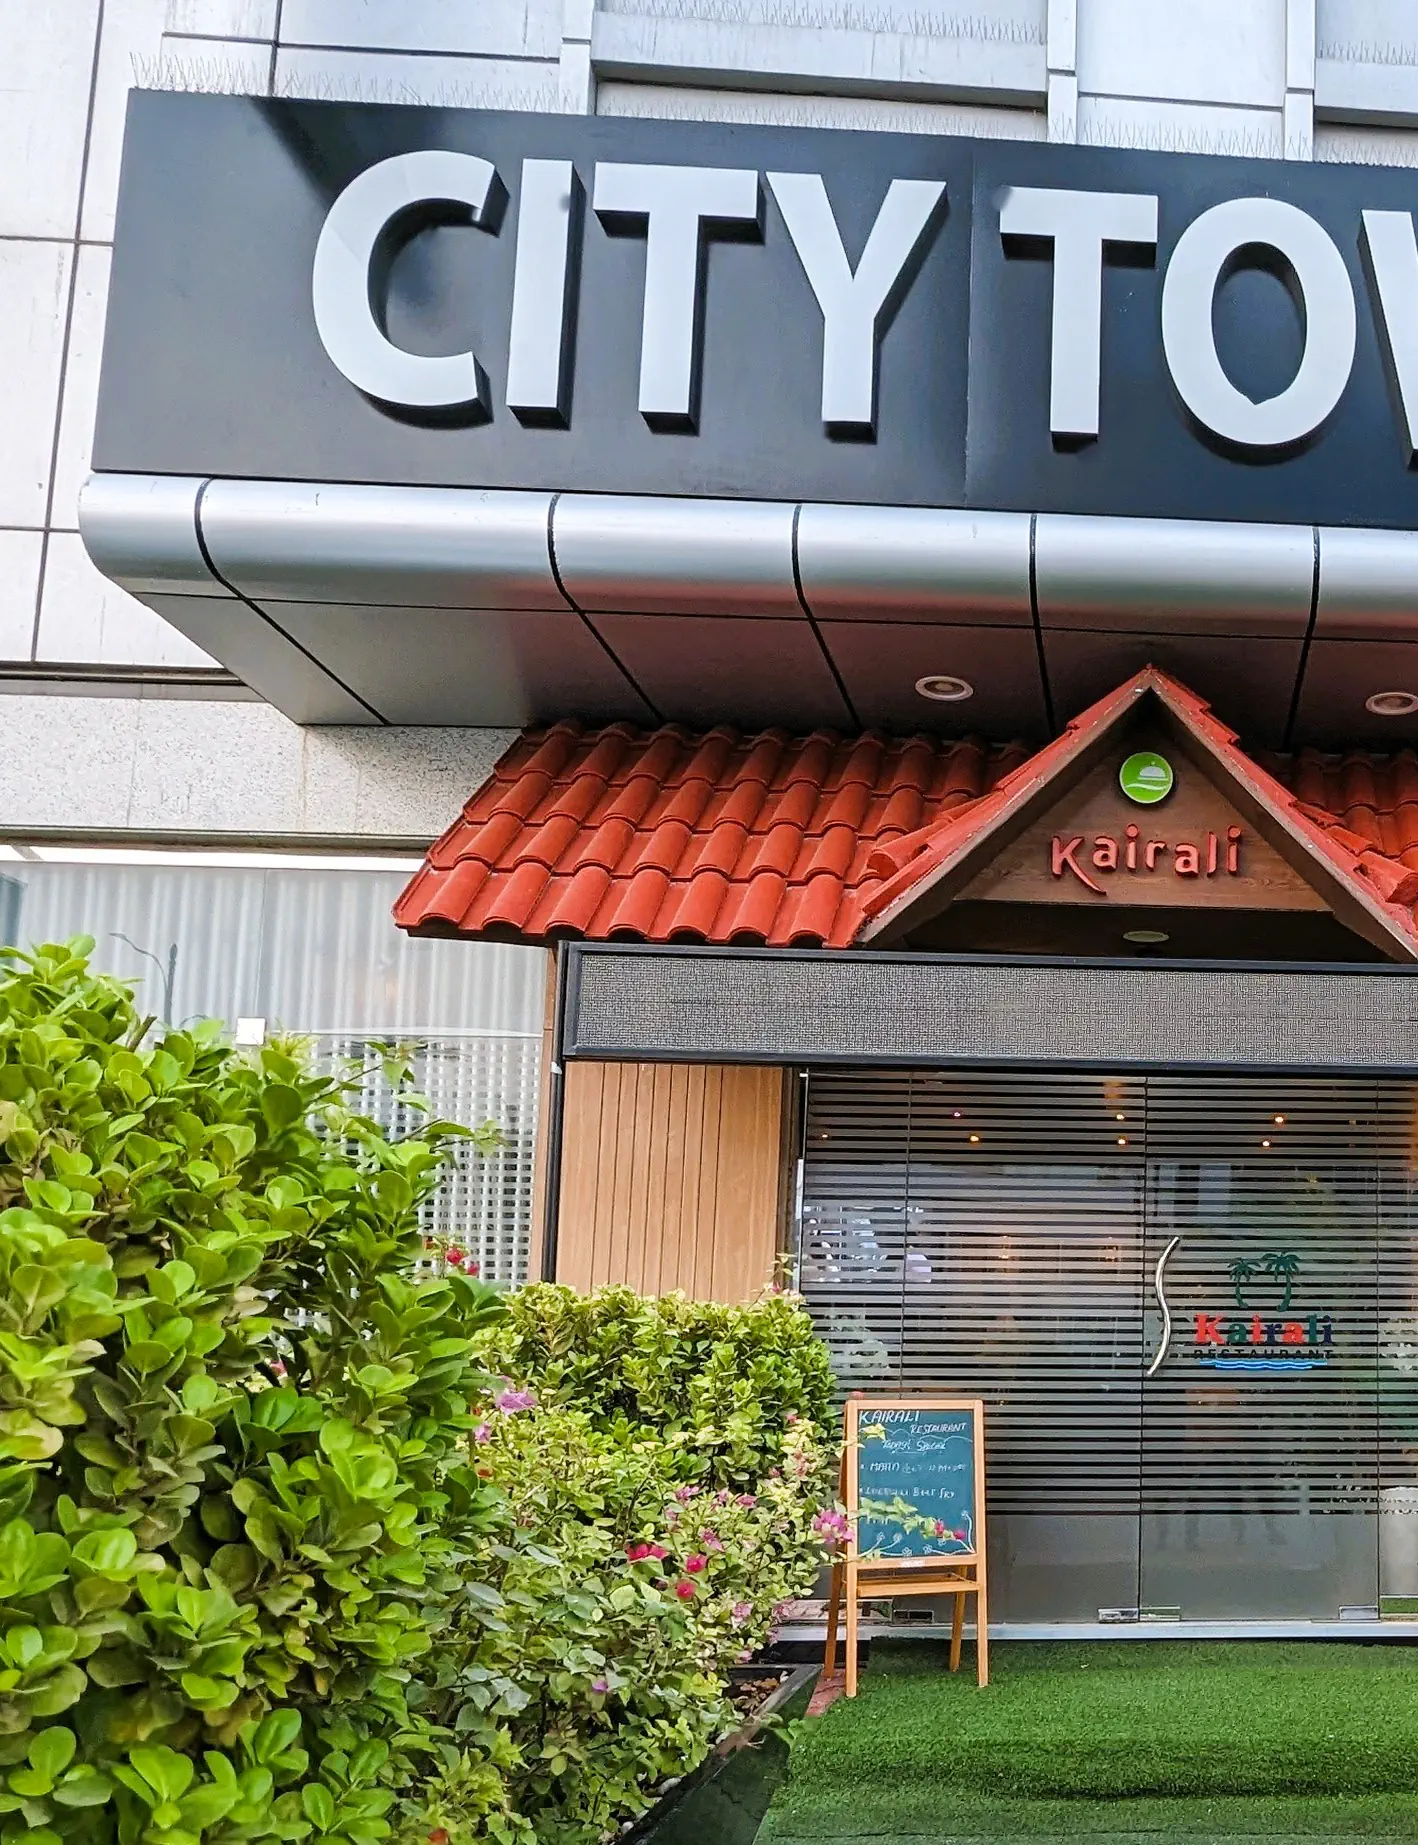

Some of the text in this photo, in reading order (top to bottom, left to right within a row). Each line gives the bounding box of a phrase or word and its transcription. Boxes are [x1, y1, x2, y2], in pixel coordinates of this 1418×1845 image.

[312, 149, 948, 442] CITY
[1051, 823, 1243, 897] Kairali
[1194, 1312, 1334, 1345] Kairali
[859, 1410, 920, 1425] KAIRALI
